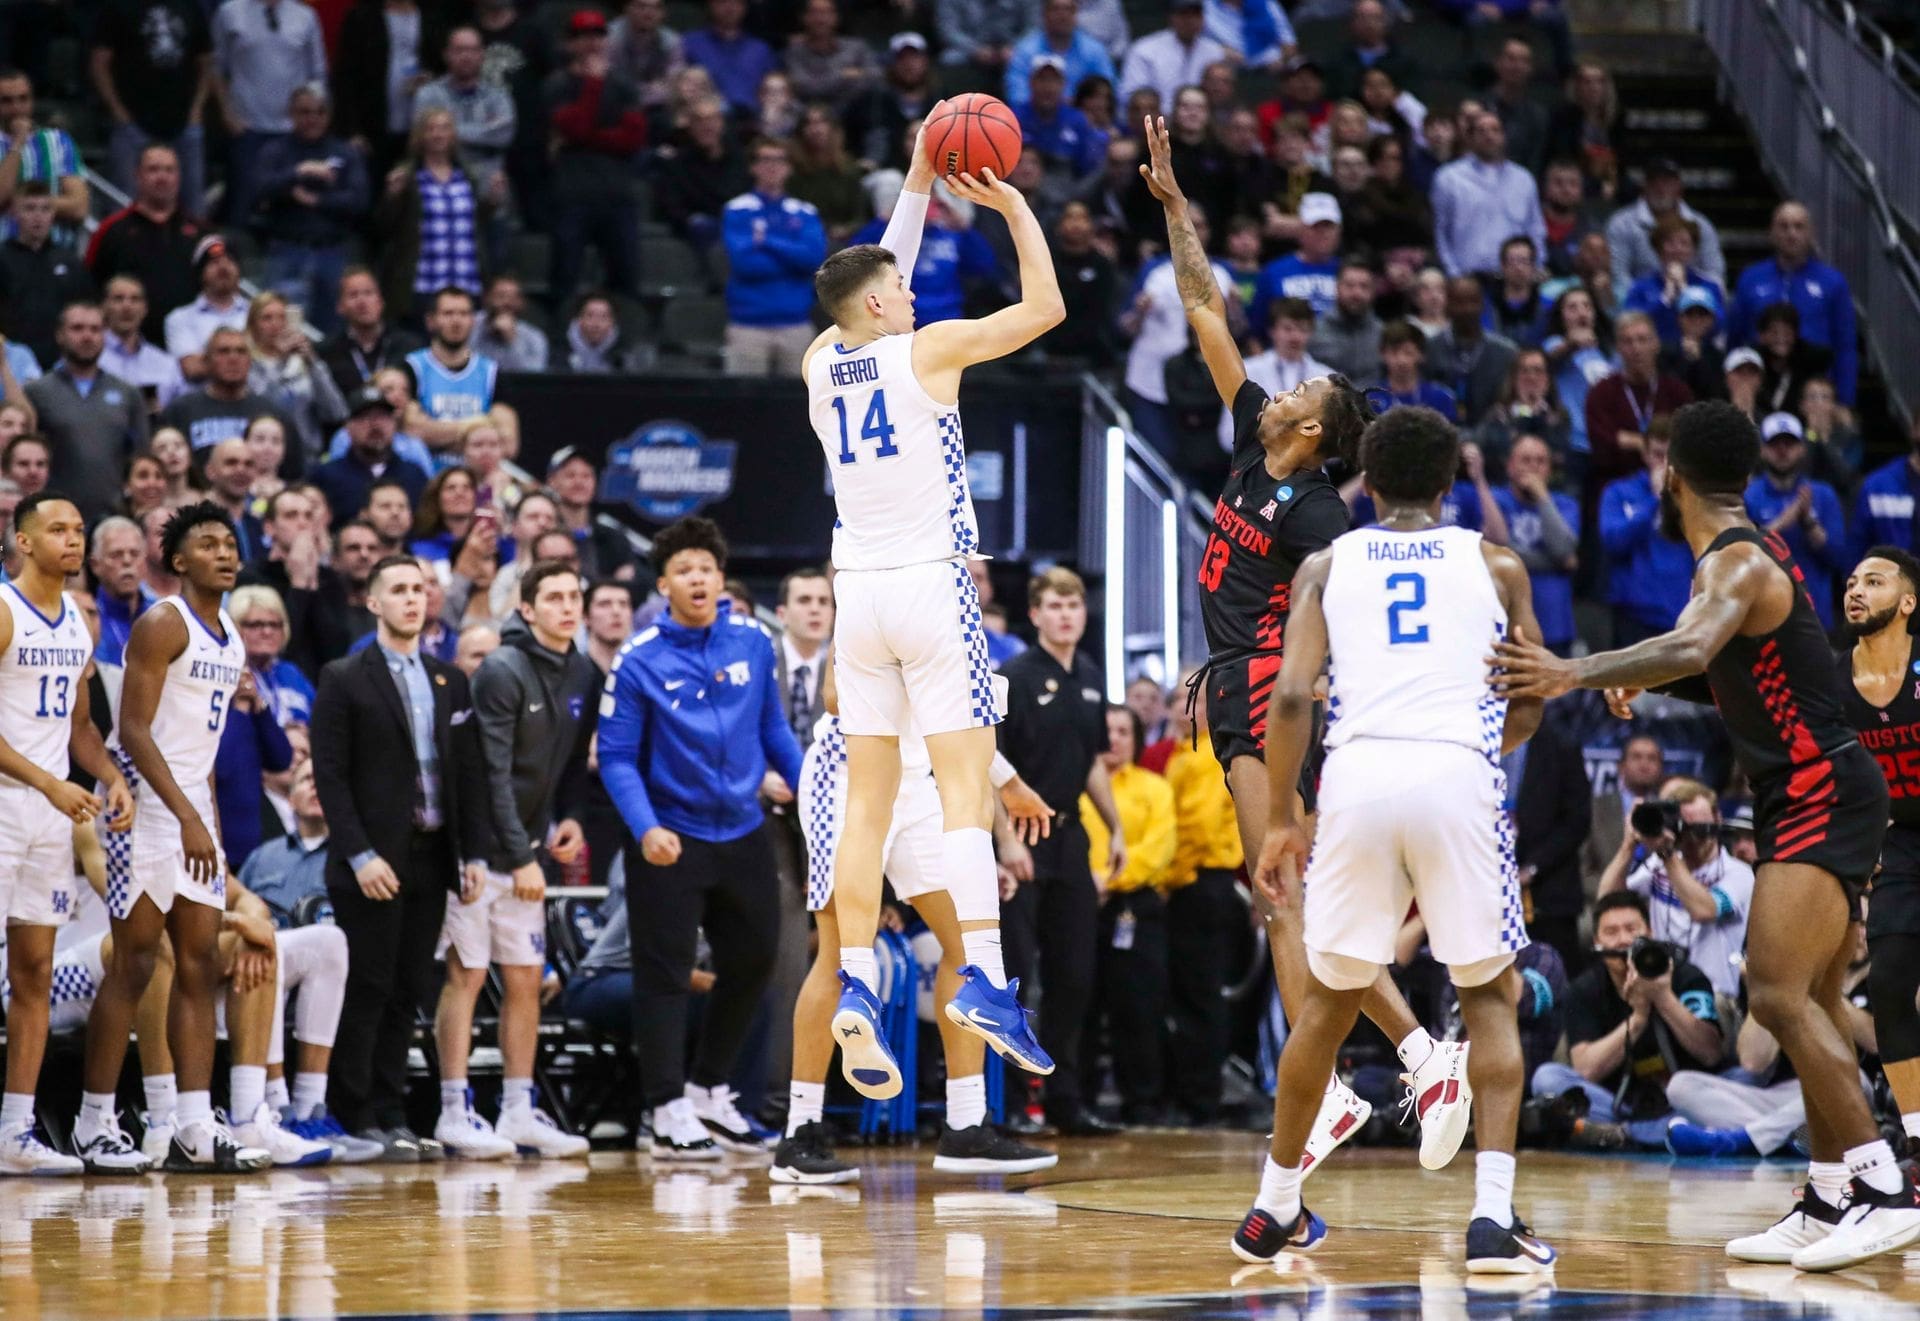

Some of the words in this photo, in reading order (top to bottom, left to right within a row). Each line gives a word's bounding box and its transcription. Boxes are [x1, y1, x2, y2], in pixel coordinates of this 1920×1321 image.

[829, 357, 879, 387] HERRO
[831, 388, 899, 464] 14
[1214, 494, 1272, 557] USTON
[1198, 532, 1230, 593] 13
[1367, 540, 1445, 561] HAGANS
[1386, 572, 1430, 645] 2
[17, 646, 86, 667] KENTUCKY
[35, 674, 70, 718] 13
[207, 689, 225, 732] 5
[1857, 721, 1920, 750] USTO
